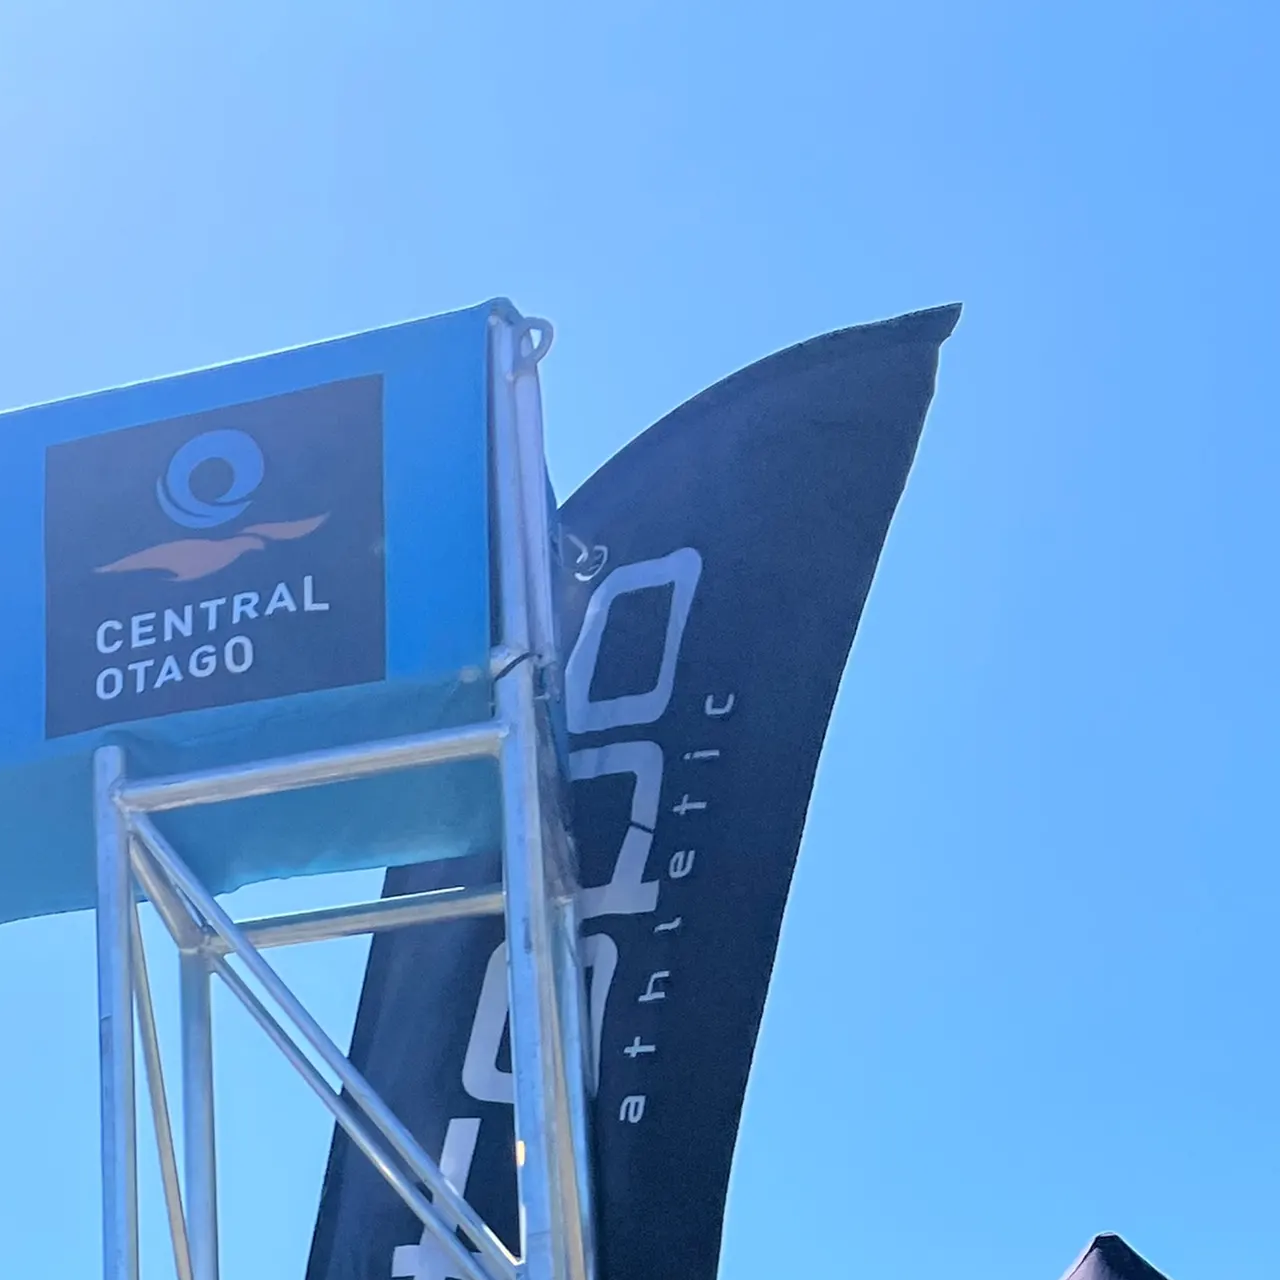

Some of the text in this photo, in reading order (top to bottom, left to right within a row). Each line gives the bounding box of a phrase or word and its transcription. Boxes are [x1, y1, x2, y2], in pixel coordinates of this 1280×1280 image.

[93, 572, 331, 656] CENTRAL
[93, 635, 255, 702] OTAGO
[618, 689, 737, 1125] athletic
